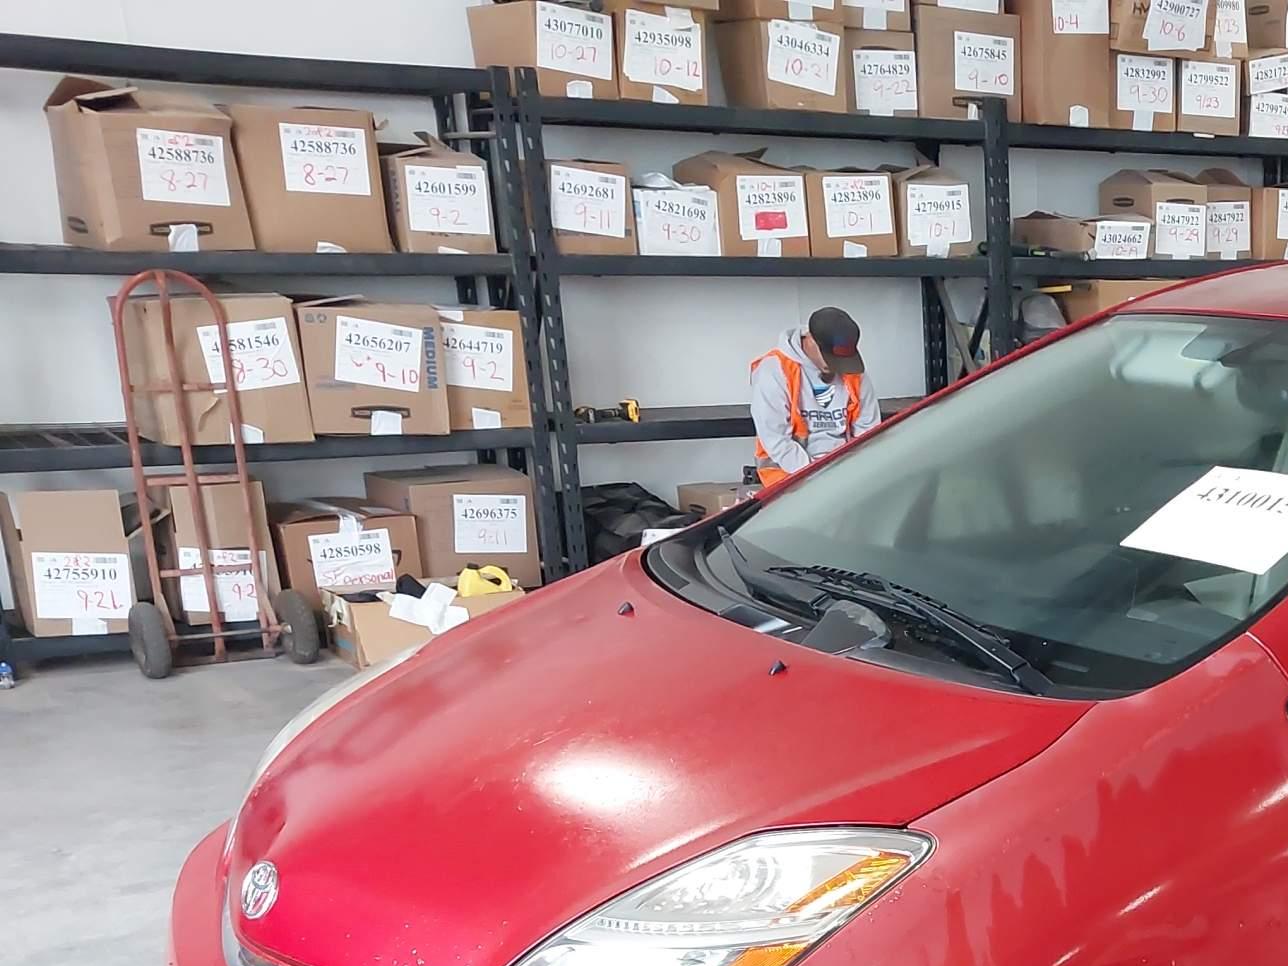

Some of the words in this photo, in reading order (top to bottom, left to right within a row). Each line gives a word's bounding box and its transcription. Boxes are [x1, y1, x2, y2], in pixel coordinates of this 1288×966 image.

[544, 17, 603, 41] 43077010
[634, 30, 692, 49] 42935098
[776, 33, 830, 57] 43046334
[550, 43, 597, 63] 10-27
[960, 45, 1007, 61] 42675845
[654, 55, 701, 77] 10-12
[860, 63, 911, 76] 42764829
[1123, 66, 1166, 81] 42832992
[1187, 73, 1229, 87] 42799522
[148, 146, 215, 165] 42588736
[290, 139, 357, 156] 42588736
[302, 163, 350, 185] 8-27
[414, 180, 477, 197] 42601599
[558, 181, 615, 201] 42692681
[831, 190, 881, 203] 42823896
[745, 191, 797, 205] 42823896
[914, 199, 962, 213] 42796915
[654, 199, 707, 221] 42821698
[1209, 212, 1244, 223] 42847922
[1161, 213, 1200, 226] 42847922
[1101, 233, 1142, 244] 43024662
[211, 333, 280, 353] 4581546
[344, 332, 411, 353] 42656207
[442, 336, 503, 354] 42644719
[423, 326, 438, 390] MEDIUM
[460, 507, 518, 520] 42696375
[319, 542, 382, 560] 42850598
[43, 567, 118, 581] 42755910
